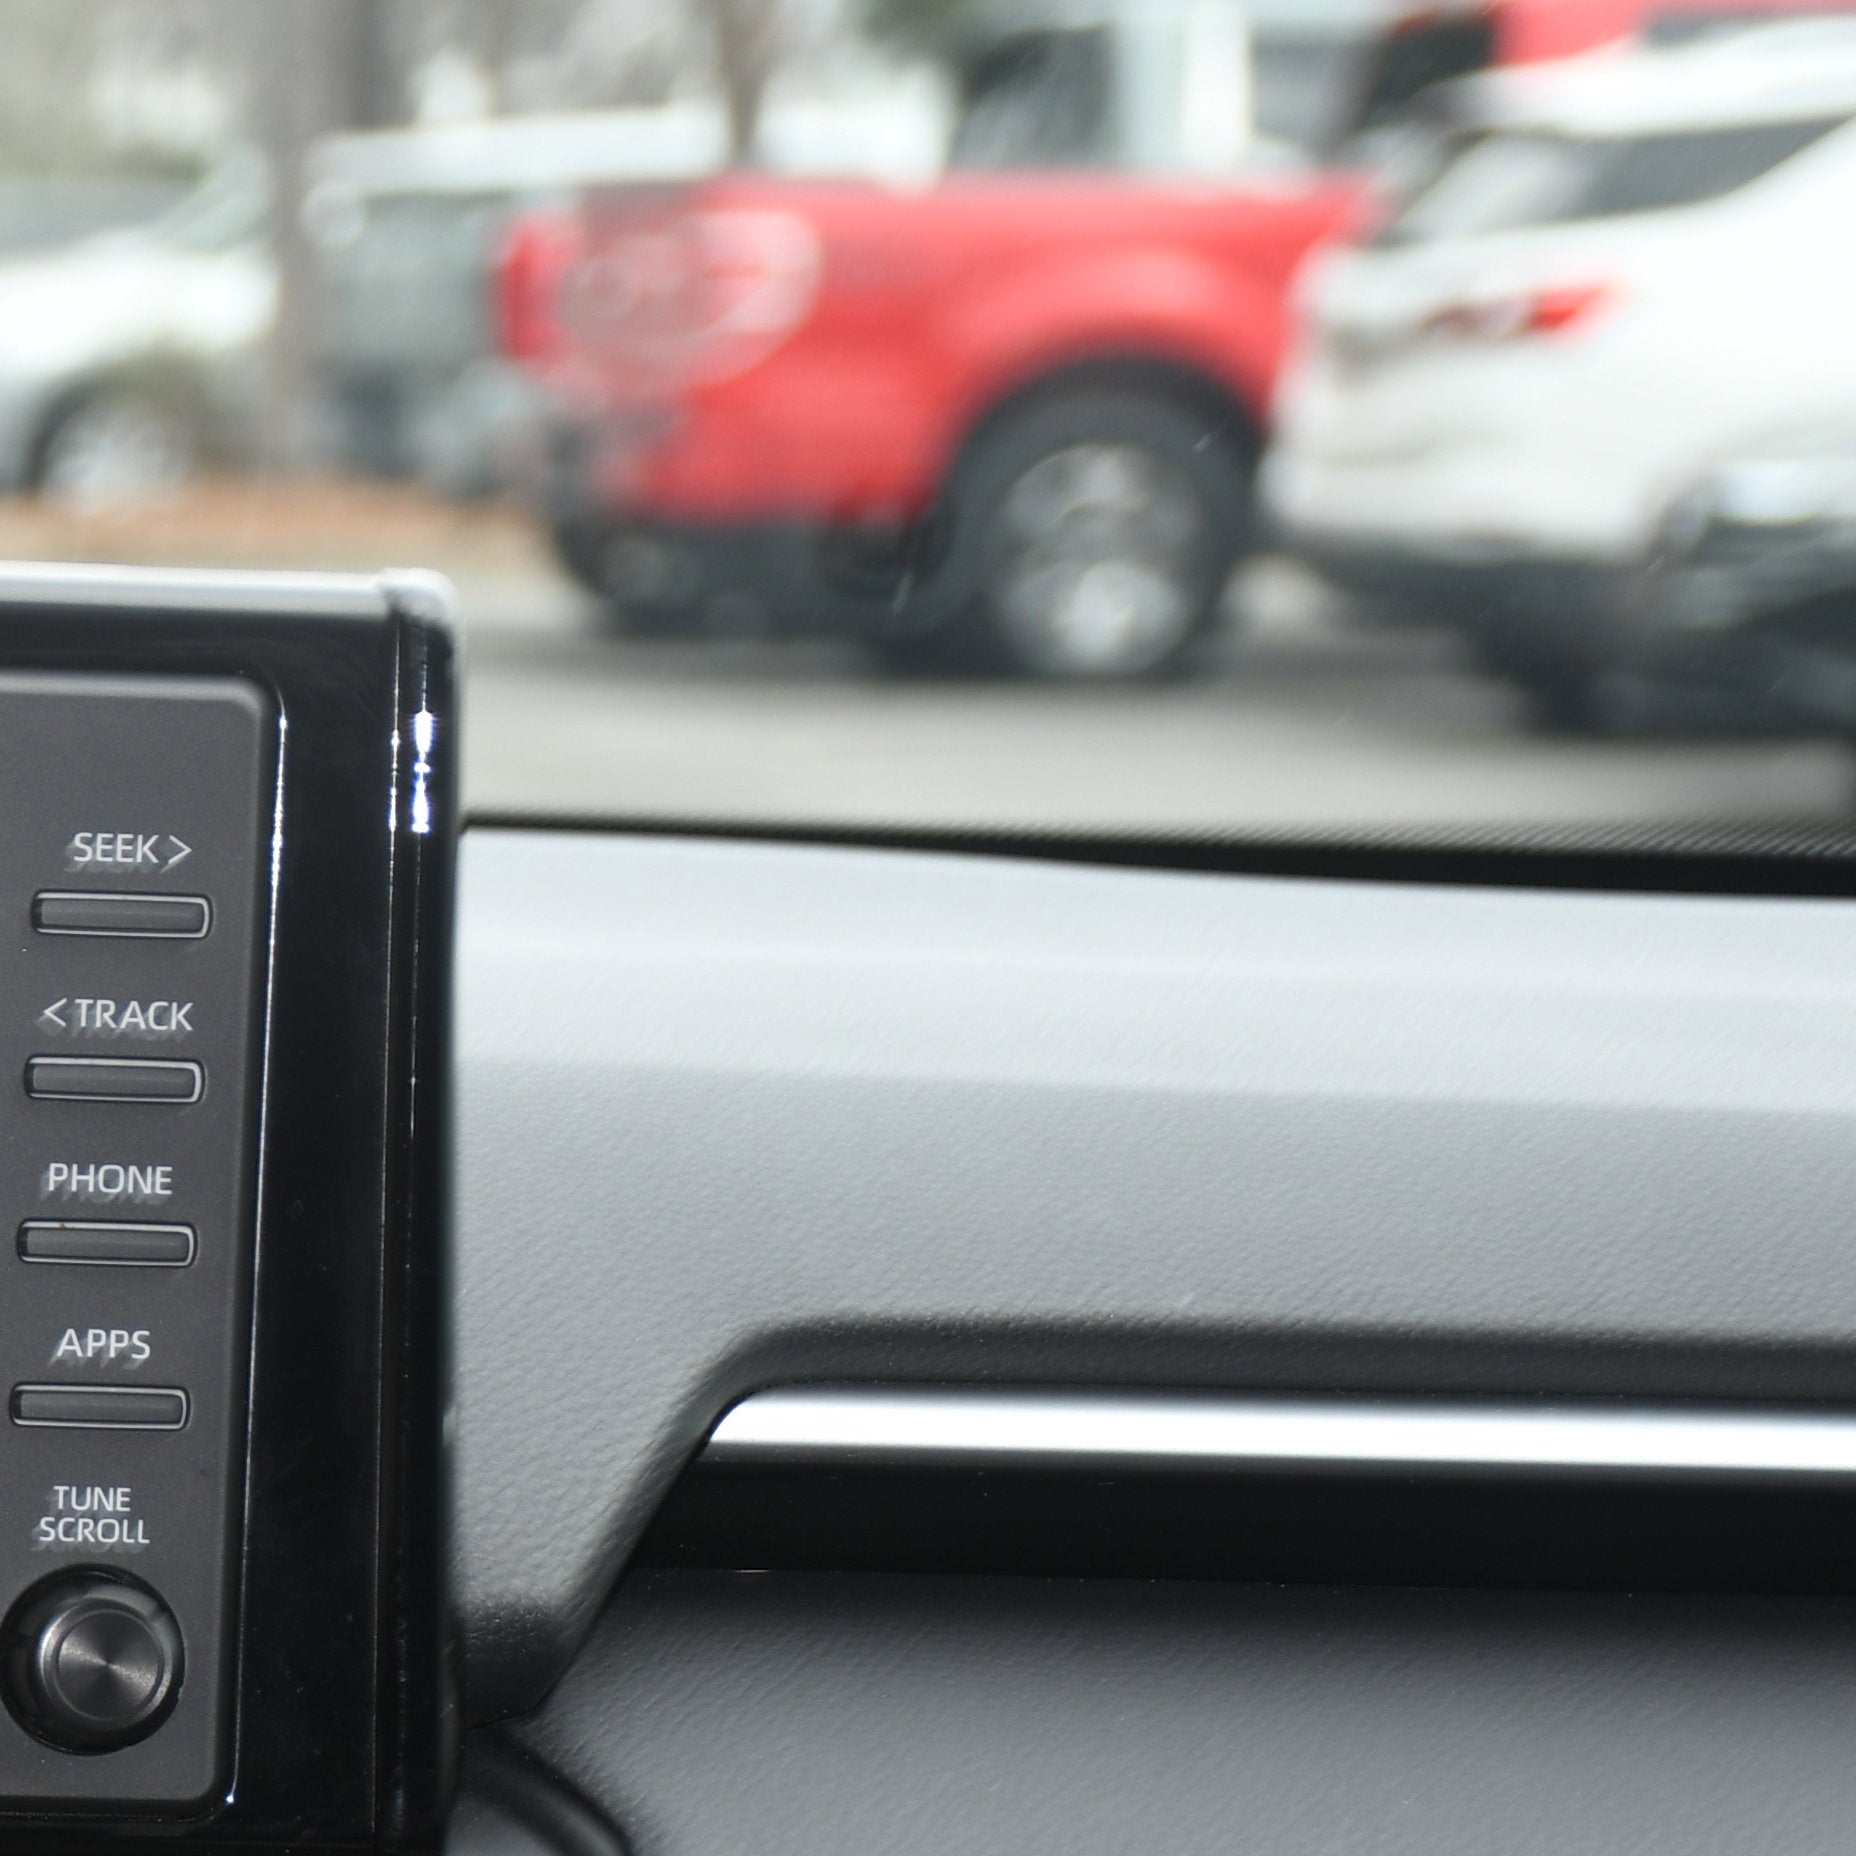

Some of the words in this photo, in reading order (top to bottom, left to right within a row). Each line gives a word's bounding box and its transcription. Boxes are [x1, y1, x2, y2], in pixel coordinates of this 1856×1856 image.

[46, 1163, 174, 1196] PHONE
[55, 1329, 153, 1361] APPS
[52, 1486, 133, 1513] TUNE
[37, 1516, 152, 1545] SCROLL
